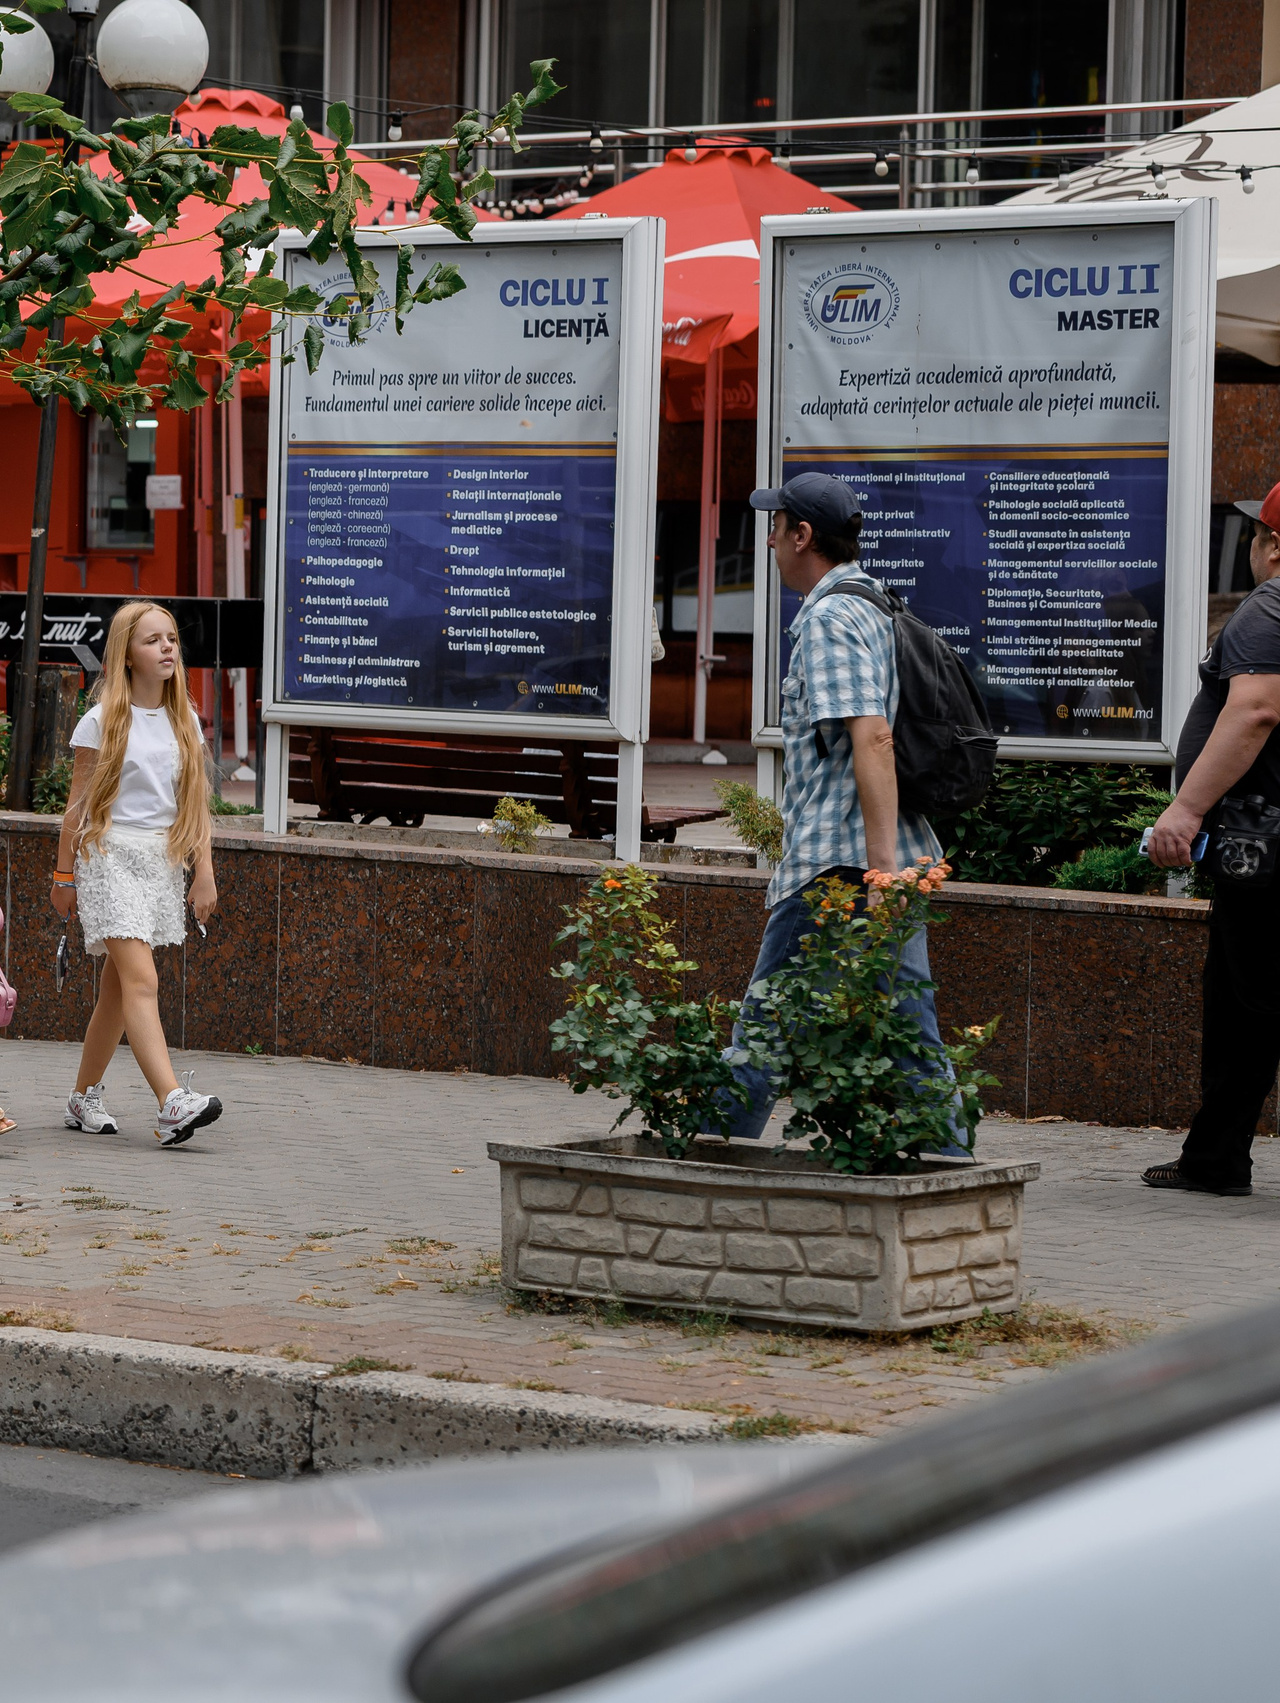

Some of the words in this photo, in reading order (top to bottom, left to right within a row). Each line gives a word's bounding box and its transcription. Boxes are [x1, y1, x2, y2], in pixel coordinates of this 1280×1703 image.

[1009, 266, 1109, 298] CICLU
[1118, 264, 1160, 294] II
[500, 279, 585, 307] CICLU
[592, 278, 609, 304] I
[820, 295, 881, 323] ULIM
[1058, 308, 1159, 331] MASTER
[524, 313, 609, 344] LICENȚĂ
[333, 368, 374, 385] Primul
[379, 374, 404, 391] pas
[408, 374, 437, 391] spre
[443, 373, 459, 385] un
[464, 369, 500, 385] viitor
[505, 366, 521, 384] de
[526, 371, 576, 384] succes.
[839, 366, 910, 392] Expertiză
[916, 364, 1002, 386] academică
[1009, 361, 1115, 389] aprofundată,
[306, 394, 389, 412] Fundamentul
[394, 396, 421, 411] unei
[427, 396, 474, 411] cariere
[479, 393, 520, 411] solide
[525, 394, 571, 417] începe
[576, 395, 605, 411] aici.
[801, 396, 868, 421] adaptată
[874, 394, 950, 420] cerințelor
[955, 392, 1013, 413] actuale
[1019, 392, 1042, 411] ale
[1048, 393, 1093, 418] pieței
[1100, 391, 1159, 410] muncii.
[309, 468, 356, 478] Traducere
[358, 469, 366, 481] și
[368, 469, 428, 480] interpretare
[454, 469, 487, 481] Design
[490, 469, 528, 479] interior
[894, 472, 903, 485] și
[989, 472, 1040, 481] Consiliere
[1042, 470, 1110, 482] educațională
[309, 482, 342, 493] (engleză
[349, 483, 389, 494] germană)
[990, 481, 998, 494] și
[1000, 482, 1054, 492] integritate
[1056, 481, 1095, 493] școlară
[453, 490, 485, 503] Relații
[487, 490, 561, 503] internaționale
[989, 500, 1040, 511] Psihologie
[1042, 499, 1079, 509] socială
[1080, 499, 1125, 511] aplicată
[452, 510, 502, 520] Jurnalism
[504, 511, 513, 524] și
[515, 513, 557, 522] procese
[885, 510, 914, 520] privat
[989, 511, 998, 520] în
[1000, 511, 1039, 520] domenii
[1041, 511, 1129, 520] socio-economice
[452, 525, 502, 534] mediatice
[885, 529, 950, 538] administrativ
[988, 529, 1018, 539] Studii
[1019, 530, 1067, 539] avansate
[1069, 529, 1078, 538] în
[1080, 529, 1131, 540] asistența
[450, 545, 479, 556] Drept
[989, 540, 1025, 550] socială
[1026, 541, 1035, 552] și
[1037, 541, 1085, 552] expertiza
[1087, 540, 1125, 550] socială
[307, 556, 382, 568] Psihopedagogie
[988, 559, 1063, 569] Managementul
[1064, 559, 1117, 569] serviciilor
[1118, 560, 1158, 569] sociale
[451, 566, 504, 578] Tehnologia
[506, 567, 565, 580] informației
[988, 570, 997, 582] și
[998, 570, 1010, 579] de
[1012, 570, 1058, 579] sănătate
[306, 576, 354, 588] Psihologie
[887, 577, 916, 586] vamal
[451, 586, 510, 596] Informatică
[987, 588, 1044, 600] Diplomație,
[1046, 589, 1104, 599] Securitate,
[305, 595, 351, 608] Asistență
[354, 597, 388, 606] socială
[988, 599, 1027, 609] Busines
[1028, 600, 1037, 611] și
[1039, 600, 1102, 609] Comunicare
[450, 606, 488, 616] Servicii
[491, 608, 527, 619] publice
[529, 610, 596, 622] estetologice
[305, 615, 368, 626] Contabilitate
[987, 617, 1062, 628] Managementul
[1124, 619, 1157, 629] Media
[448, 627, 488, 637] Servicii
[490, 628, 539, 640] hoteliere,
[305, 635, 340, 647] Finanțe
[342, 636, 350, 648] și
[353, 636, 377, 646] bănci
[987, 635, 1013, 645] Limbi
[1014, 636, 1051, 645] străine
[1053, 637, 1062, 648] și
[1064, 638, 1141, 648] managementul
[448, 641, 481, 651] turism
[484, 642, 492, 655] și
[495, 645, 545, 654] agrement
[987, 647, 1045, 656] comunicării
[1047, 647, 1060, 657] de
[1062, 648, 1124, 658] specialitate
[304, 654, 346, 664] Business
[358, 656, 420, 667] administrare
[987, 665, 1061, 676] Managementul
[1063, 666, 1118, 676] sistemelor
[303, 674, 353, 686] Marketing
[364, 676, 407, 687] logistică
[987, 676, 1045, 685] informatice
[1046, 677, 1056, 688] și
[1057, 678, 1095, 687] analiza
[1097, 678, 1135, 688] datelor
[1073, 706, 1153, 719] www.ULIM.md
